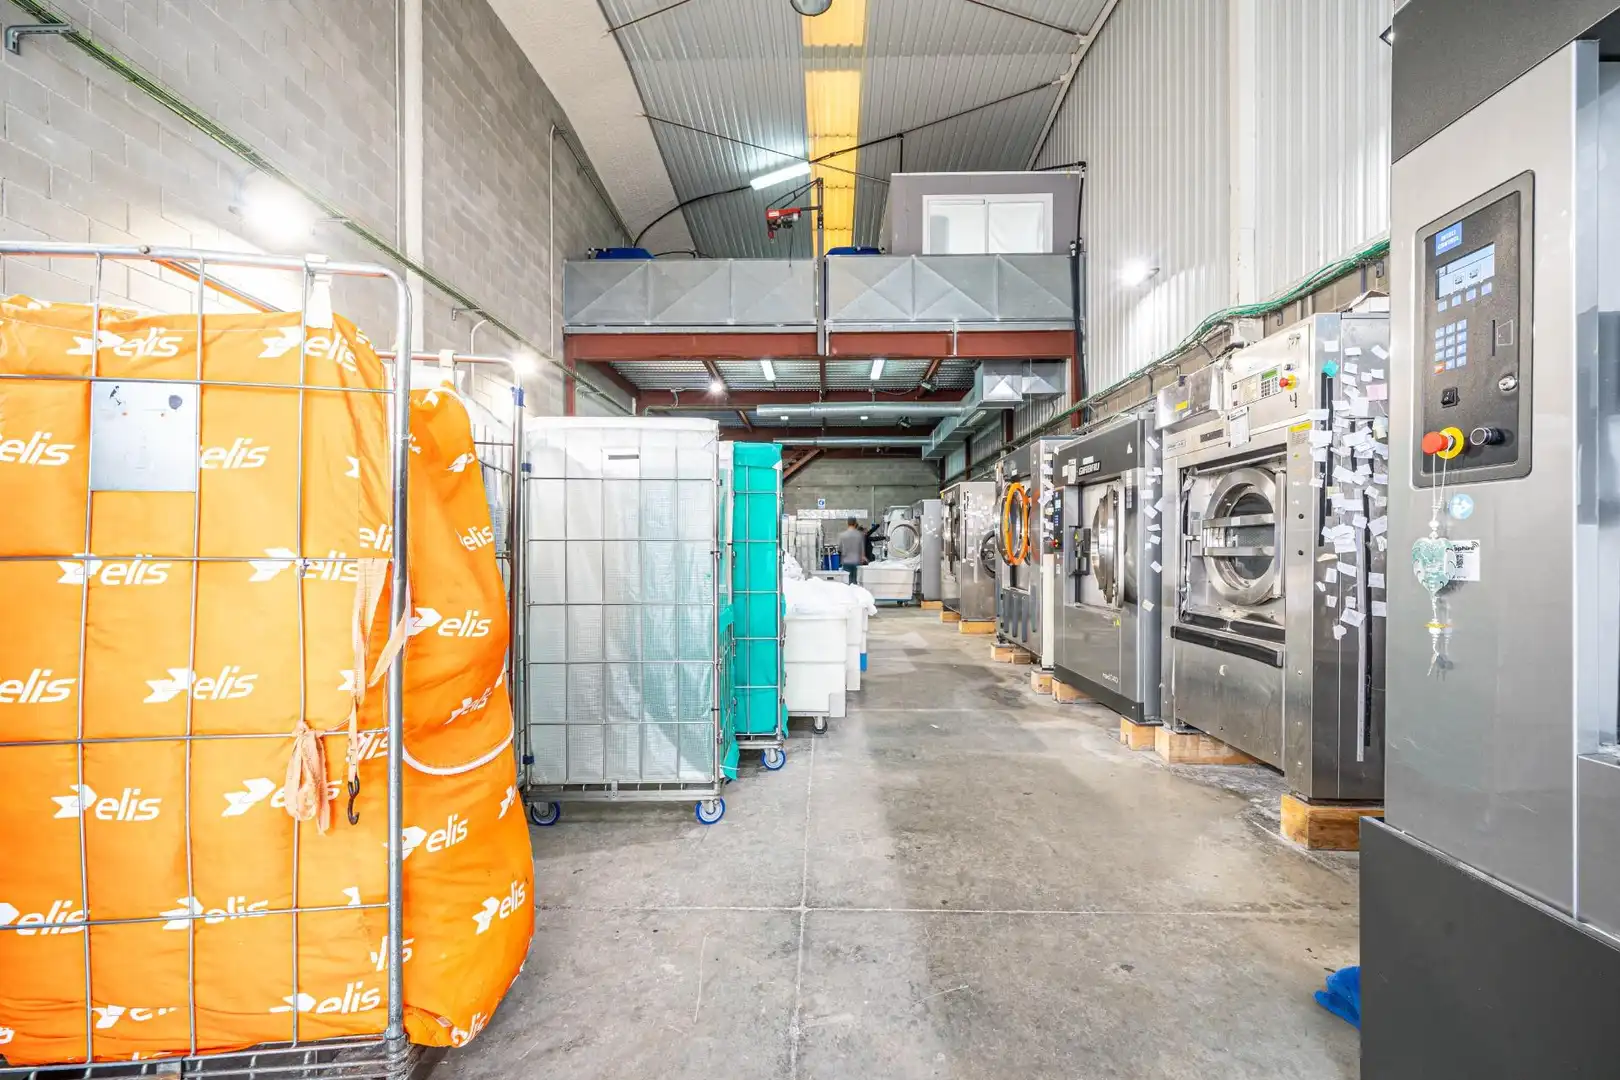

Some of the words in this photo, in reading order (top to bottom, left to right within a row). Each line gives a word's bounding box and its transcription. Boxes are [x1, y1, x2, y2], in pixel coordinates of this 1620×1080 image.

[1289, 392, 1298, 408] 4
[0, 431, 76, 466] elis
[201, 437, 270, 469] elis
[463, 525, 494, 551] elis
[101, 554, 172, 586] elis
[438, 609, 492, 637] elis
[0, 668, 76, 704] elis
[193, 665, 259, 701] elis
[95, 787, 162, 821] elis
[427, 813, 468, 852] elis
[499, 880, 526, 920] elis
[17, 900, 91, 936] elis
